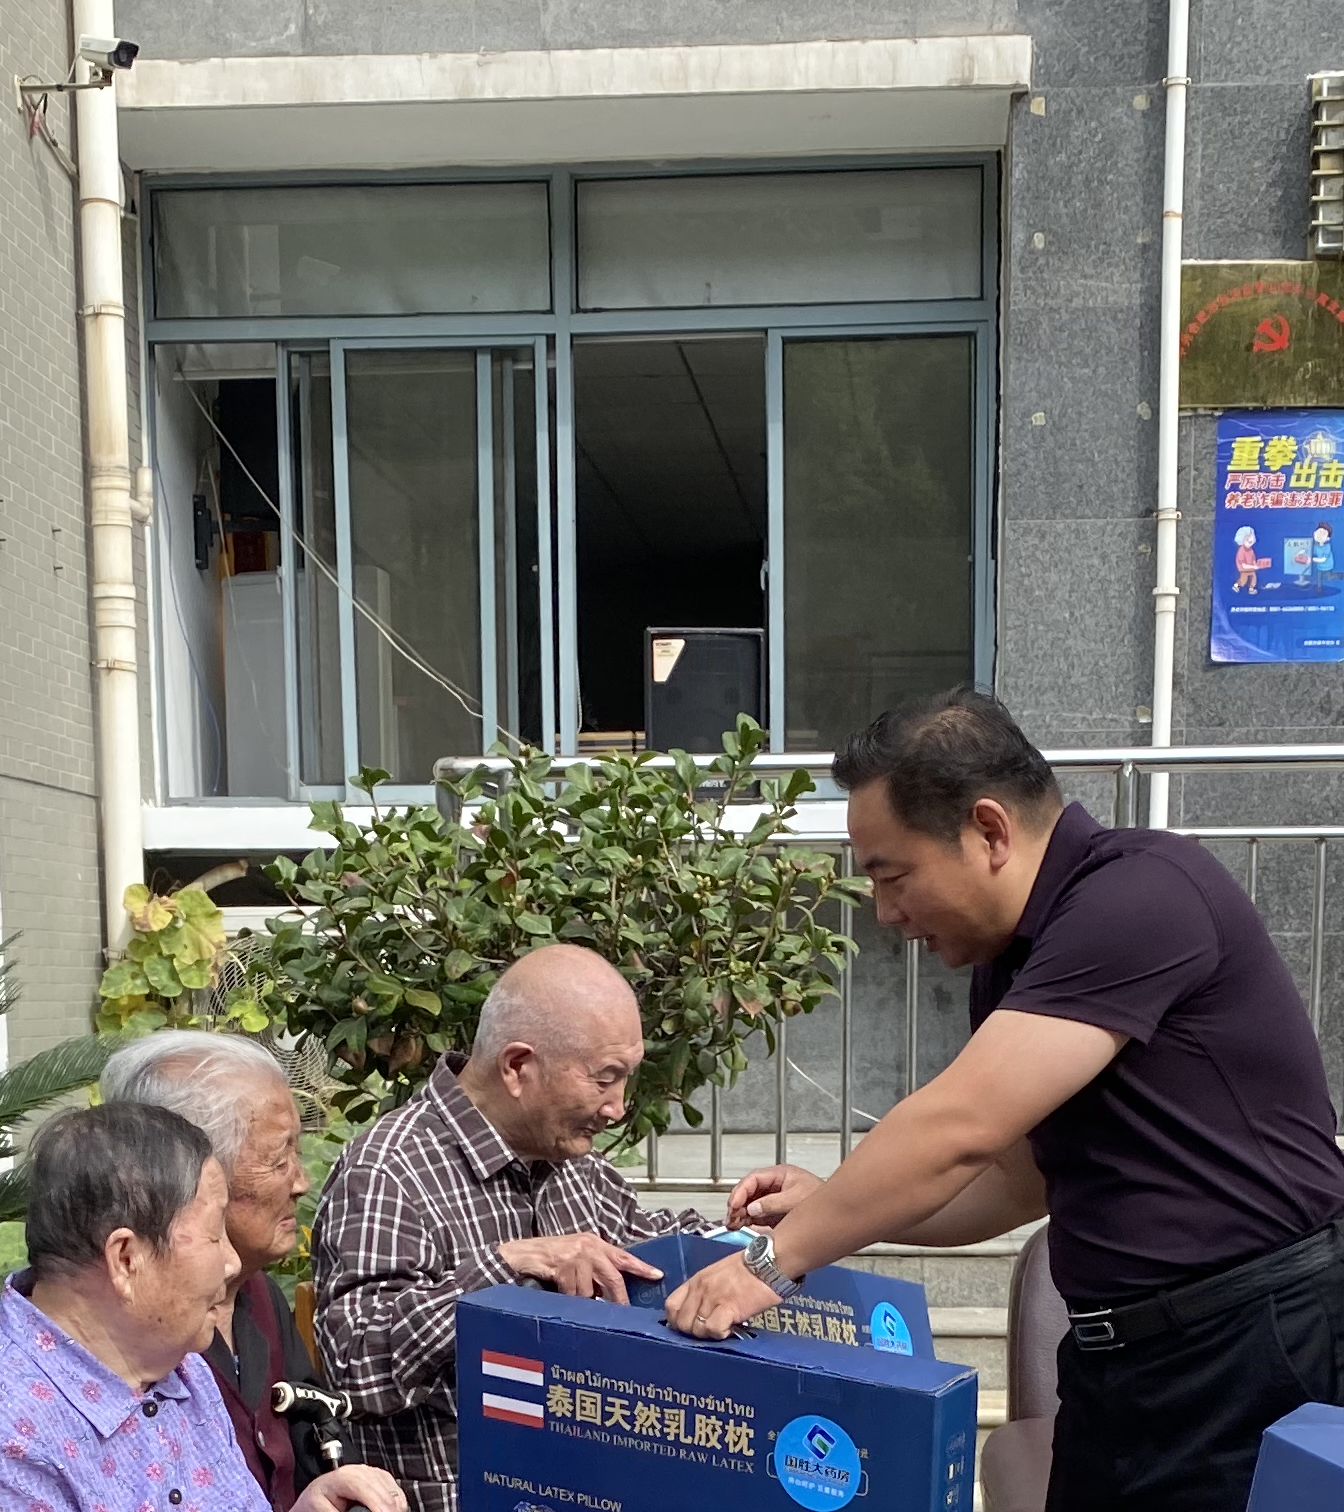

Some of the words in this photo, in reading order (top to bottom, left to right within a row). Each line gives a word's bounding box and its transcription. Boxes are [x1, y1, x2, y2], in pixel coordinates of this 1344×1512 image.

[1226, 434, 1299, 472] 重拳
[1224, 471, 1287, 491] 严厉打击
[1224, 490, 1344, 509] 养老诈骗违法犯罪
[545, 1383, 756, 1457] 泰国天然乳胶枕
[548, 1420, 611, 1444] THAILAND
[613, 1433, 677, 1458] IMPORTED
[679, 1447, 709, 1465] RAW
[712, 1453, 755, 1475] LATEX
[483, 1470, 537, 1495] NATURAL
[538, 1483, 575, 1503] LATEX
